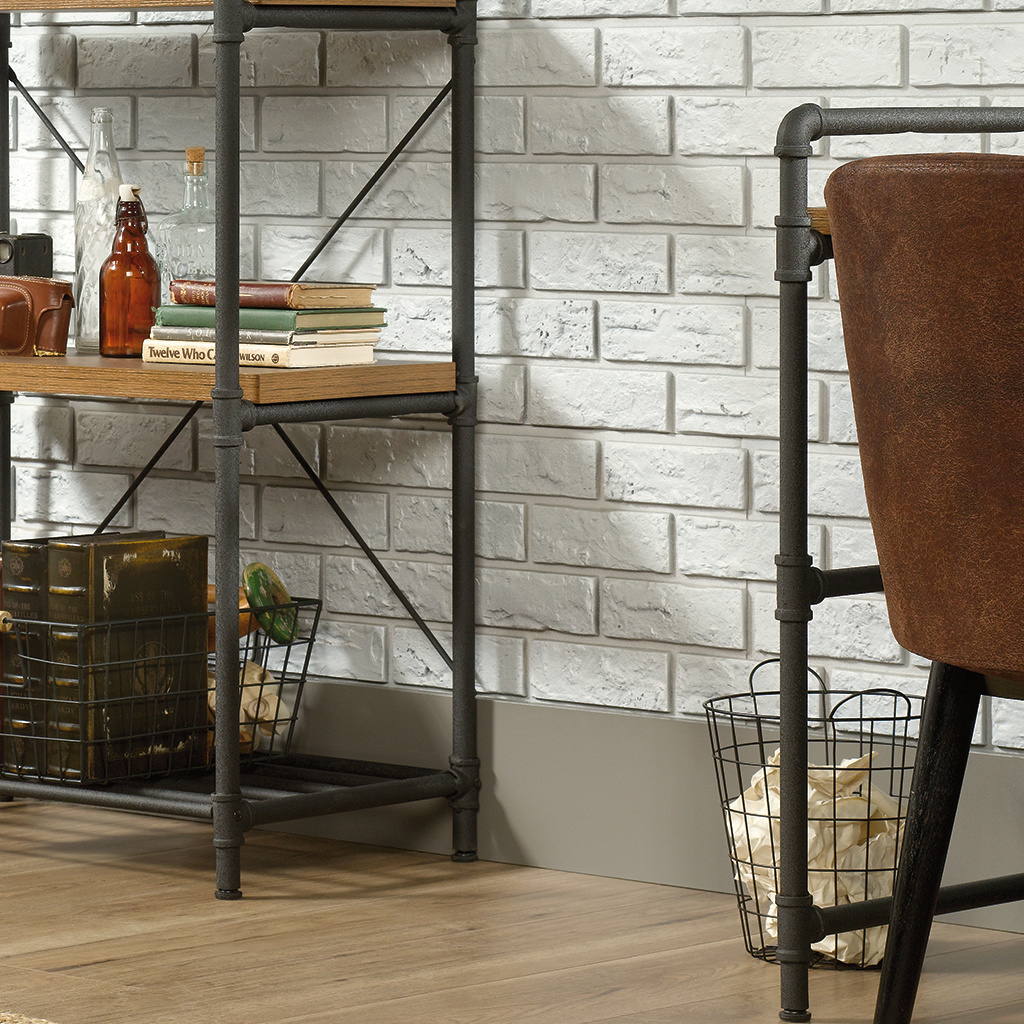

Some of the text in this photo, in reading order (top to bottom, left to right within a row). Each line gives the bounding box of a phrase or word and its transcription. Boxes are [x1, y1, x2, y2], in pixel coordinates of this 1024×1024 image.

[147, 346, 181, 359] Twelve
[181, 347, 206, 360] Who
[239, 352, 266, 362] WILSON
